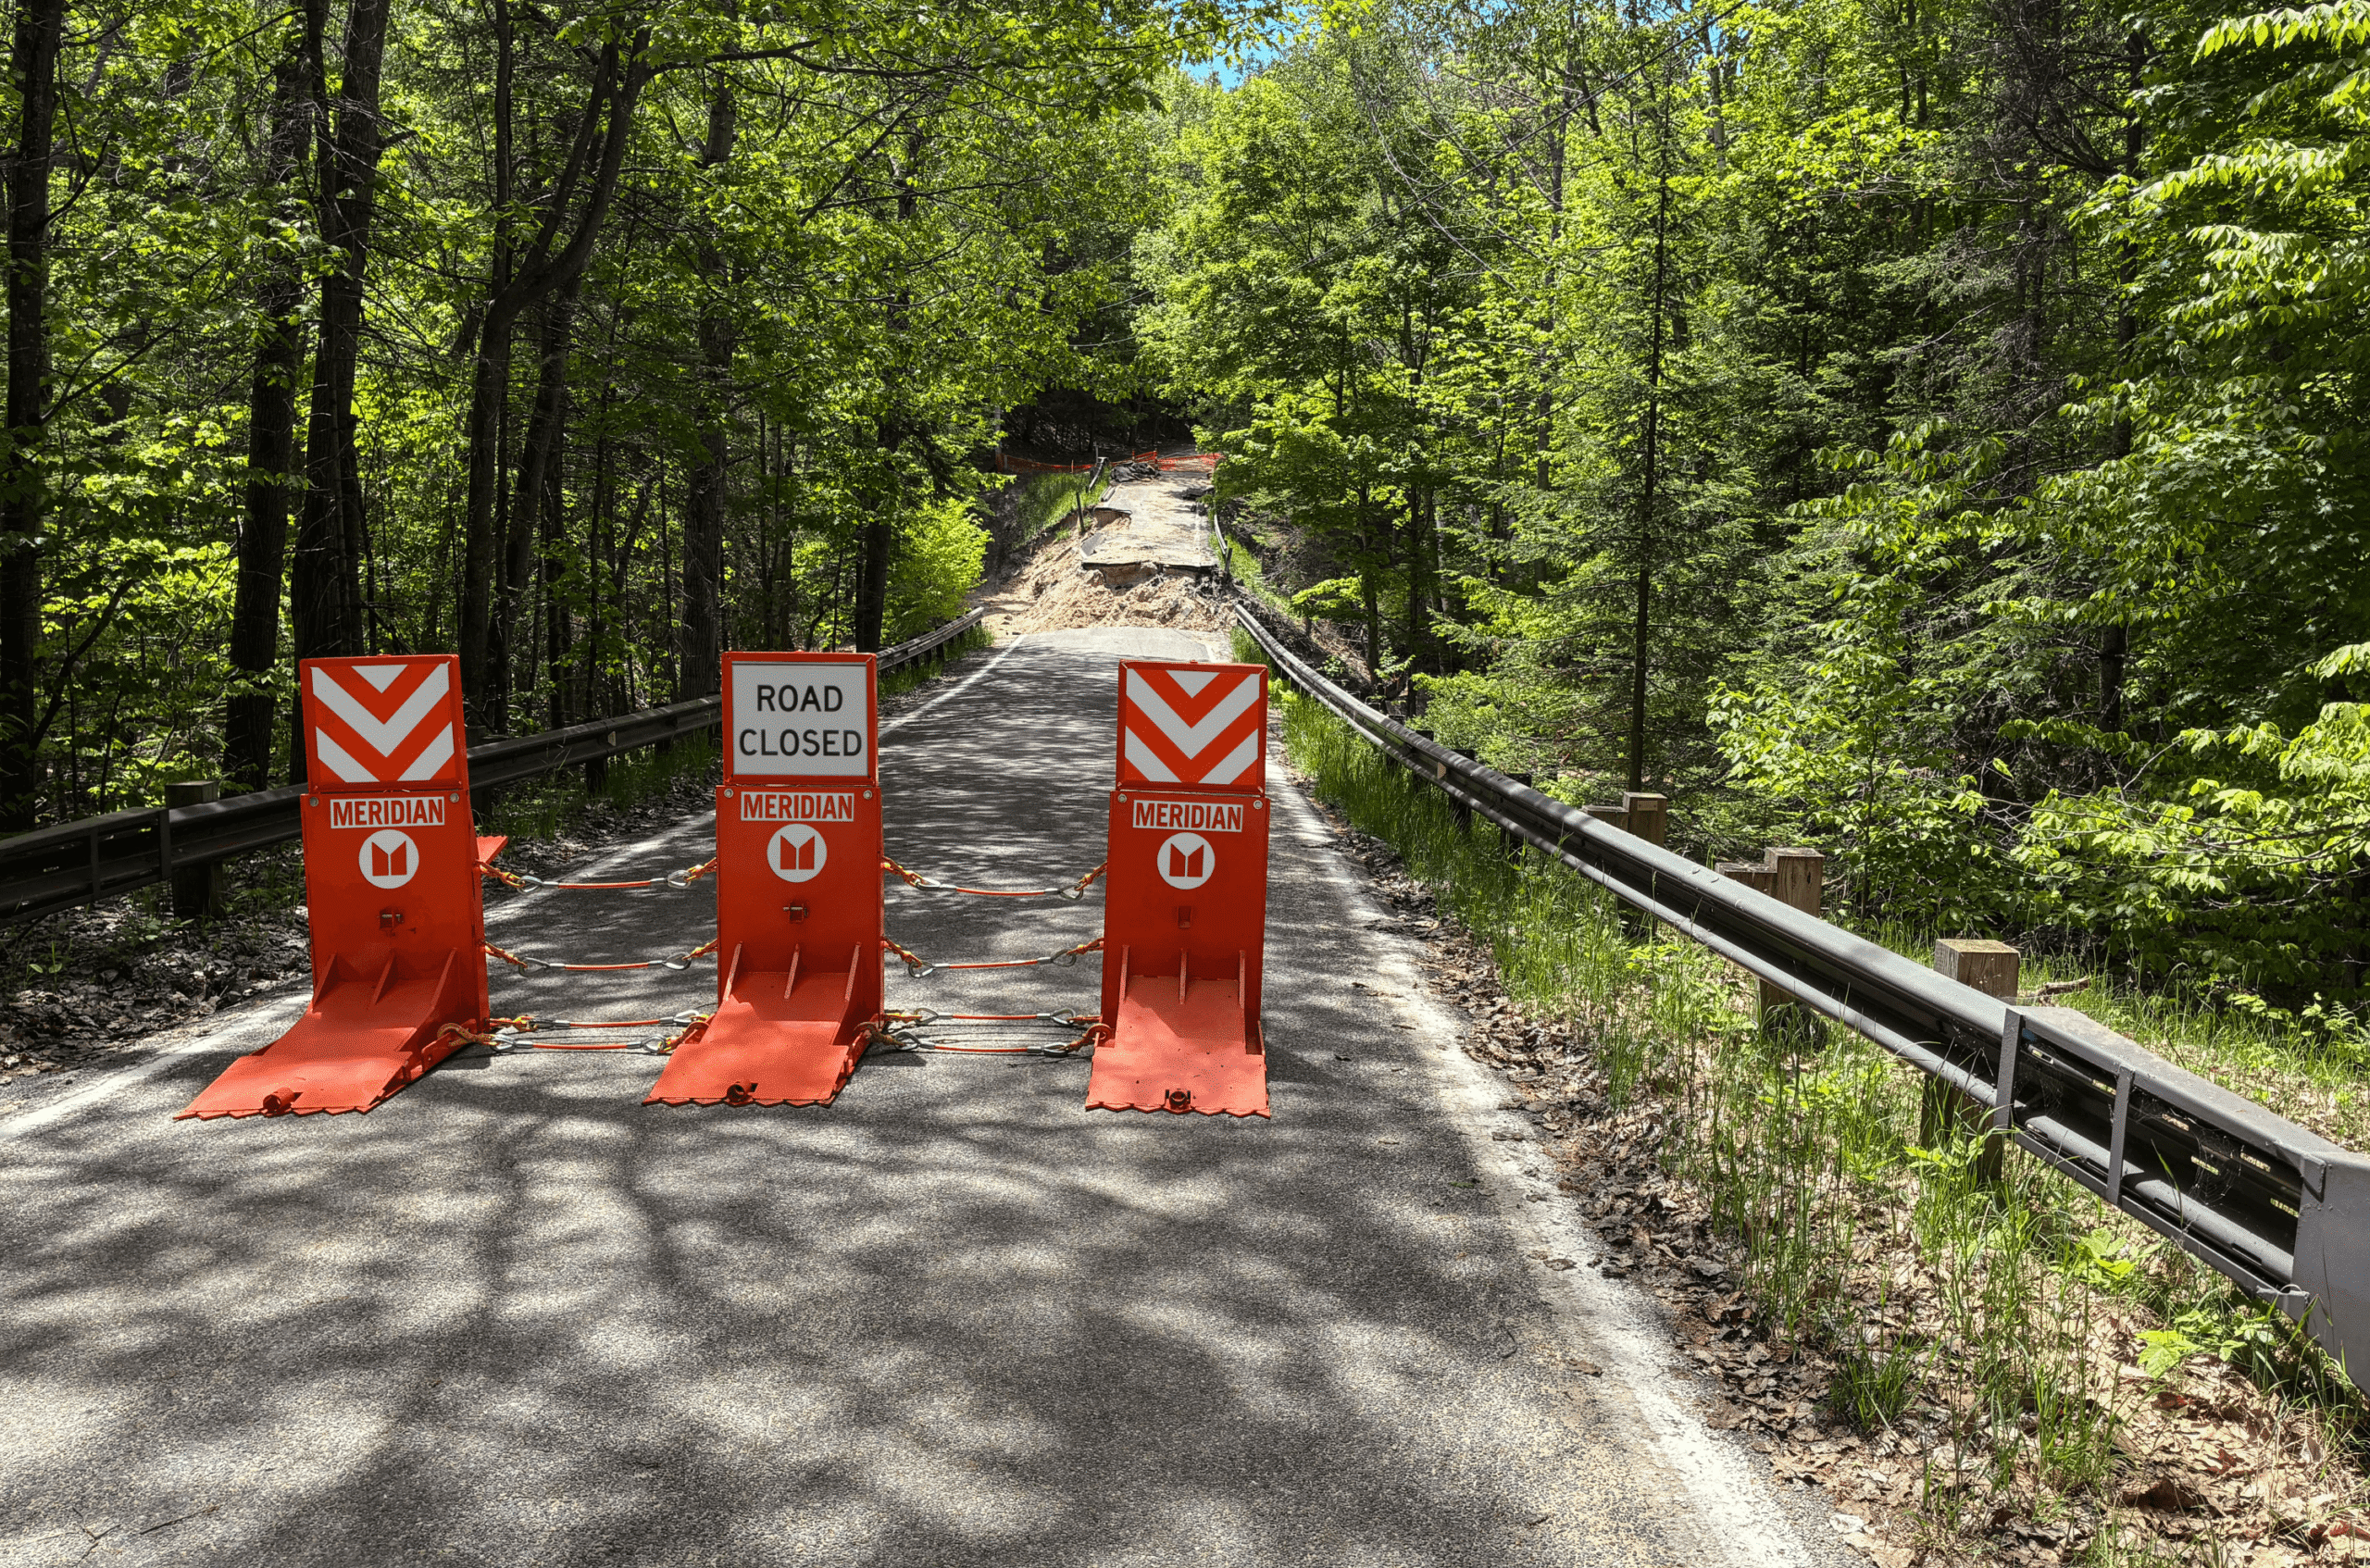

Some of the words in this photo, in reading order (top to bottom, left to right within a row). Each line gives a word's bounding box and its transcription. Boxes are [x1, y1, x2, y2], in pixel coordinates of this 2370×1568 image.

[757, 684, 843, 713] ROAD
[739, 728, 863, 757] CLOSED
[332, 799, 443, 827] MERIDIAN
[743, 793, 853, 820] MERIDIAN
[1135, 803, 1241, 830] MERIDIAN
